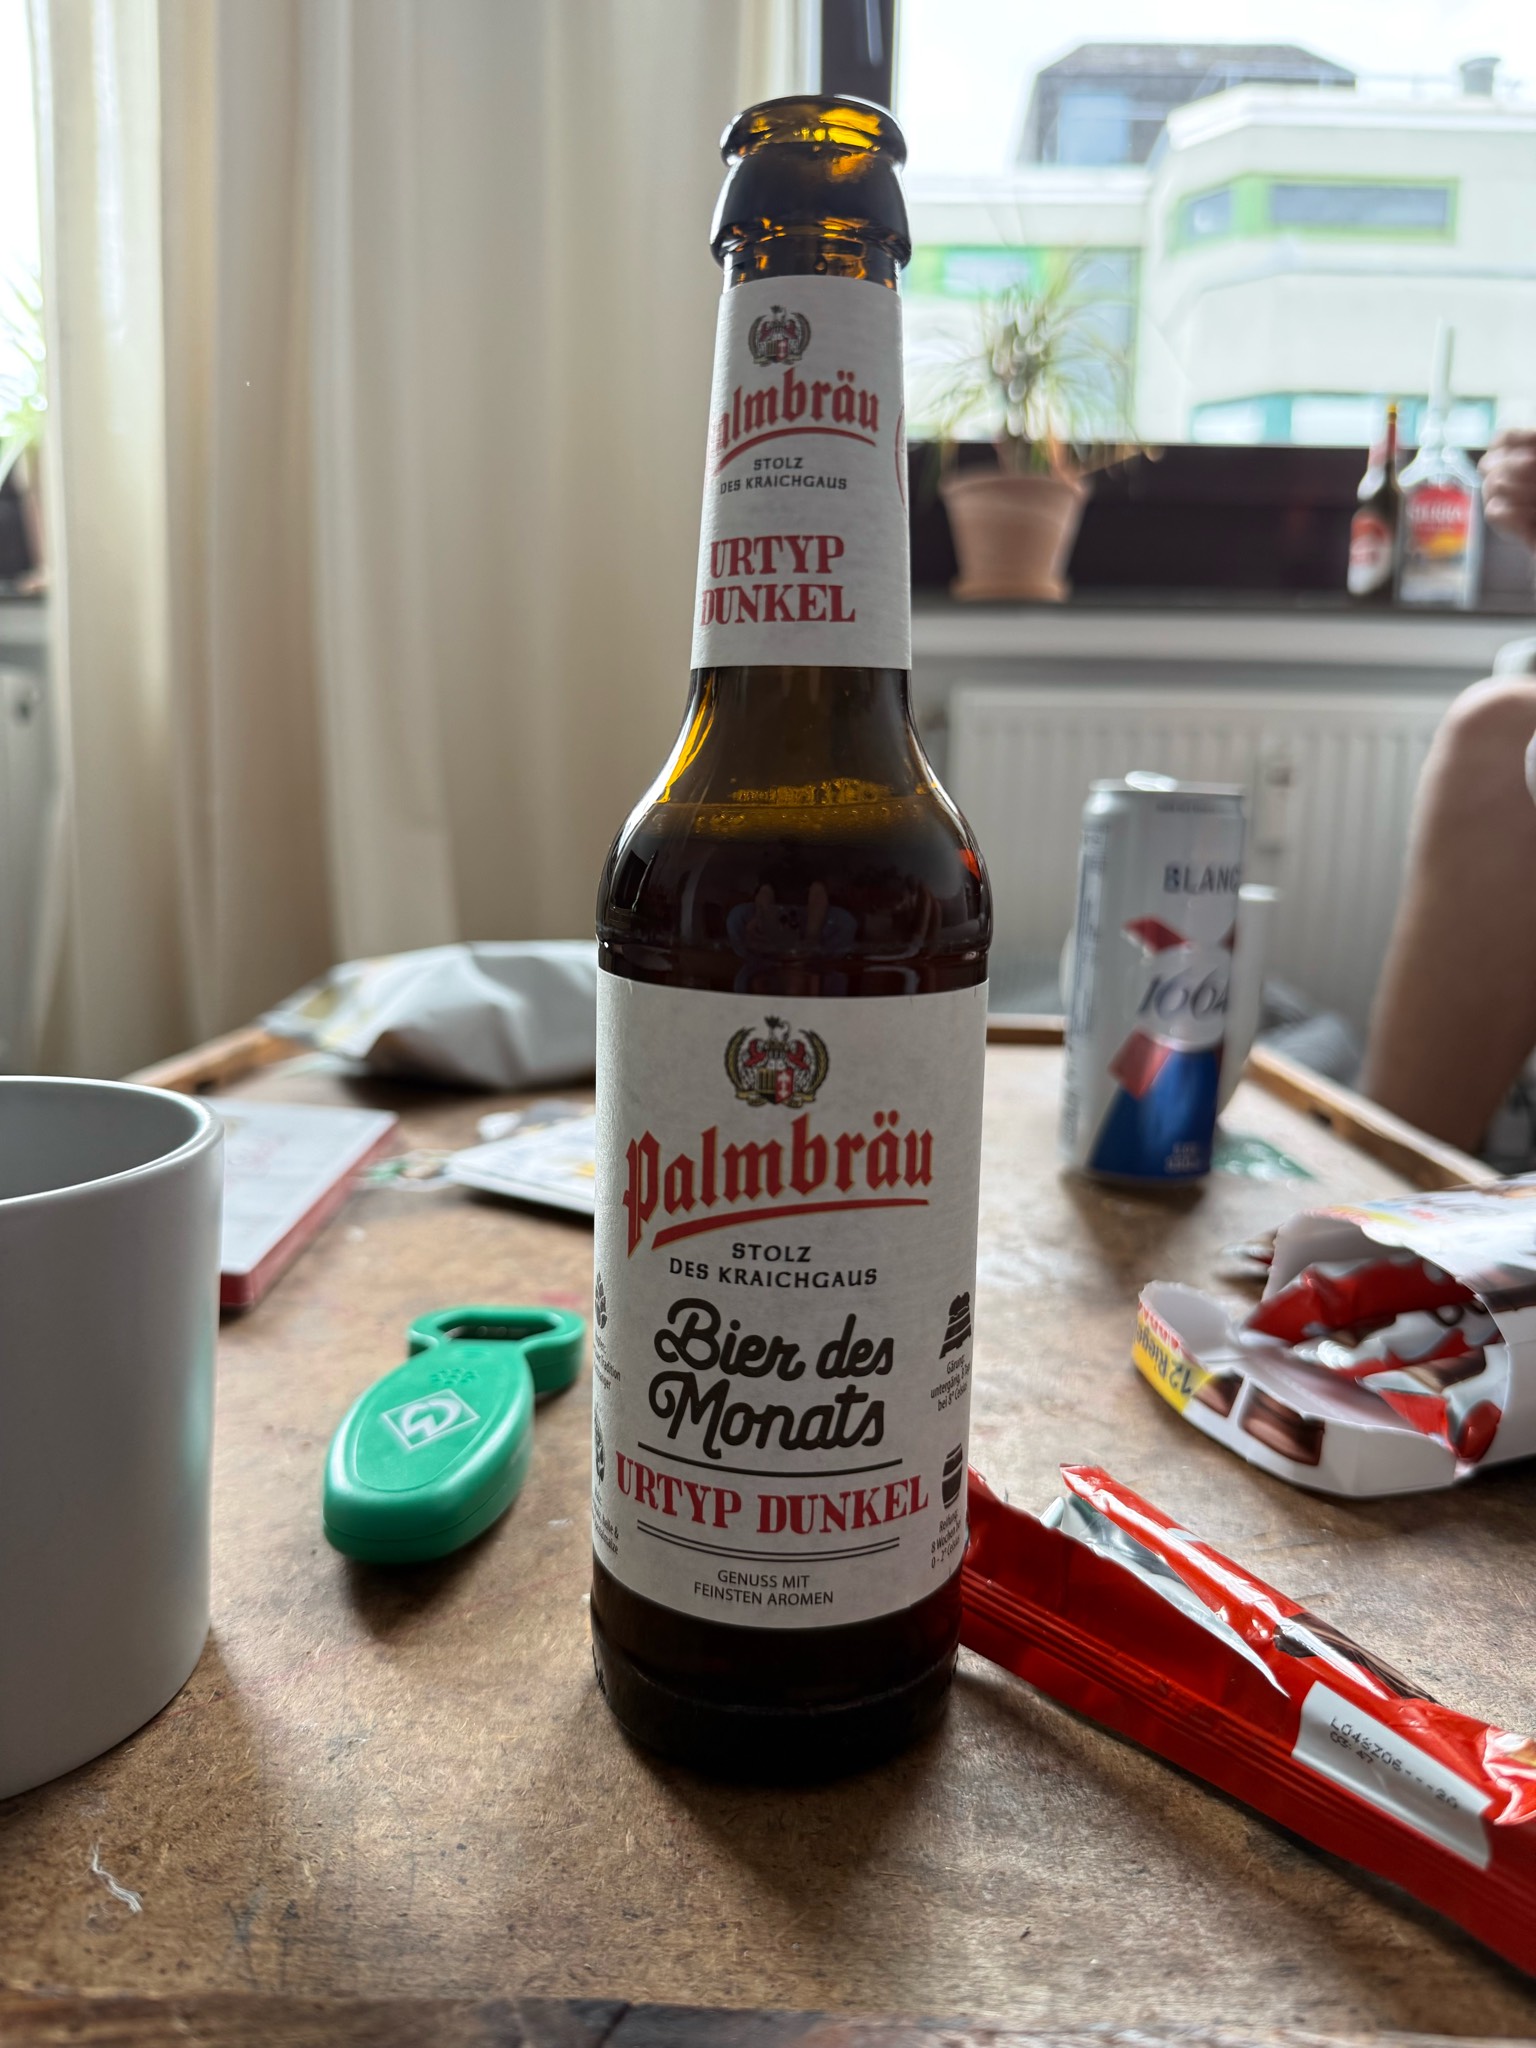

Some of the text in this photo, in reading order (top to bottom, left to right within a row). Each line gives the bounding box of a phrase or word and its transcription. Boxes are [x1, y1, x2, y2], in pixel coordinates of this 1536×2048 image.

[715, 367, 880, 449] almbräu
[720, 475, 848, 495] DES KRAICHGAUS
[753, 457, 804, 471] STOLZ
[710, 535, 846, 579] URTYP
[700, 583, 856, 627] DUNKEL
[623, 1110, 934, 1259] Palmbräu
[669, 1257, 878, 1289] DES KRAICHGAUS
[732, 1242, 812, 1263] STOLZ
[653, 1298, 895, 1382] Bier des
[648, 1371, 885, 1459] Monats
[615, 1450, 929, 1535] URTYP DUNKEL
[694, 1581, 834, 1606] FEINSTEN AROMEN
[717, 1569, 811, 1589] GENUSS MIT
